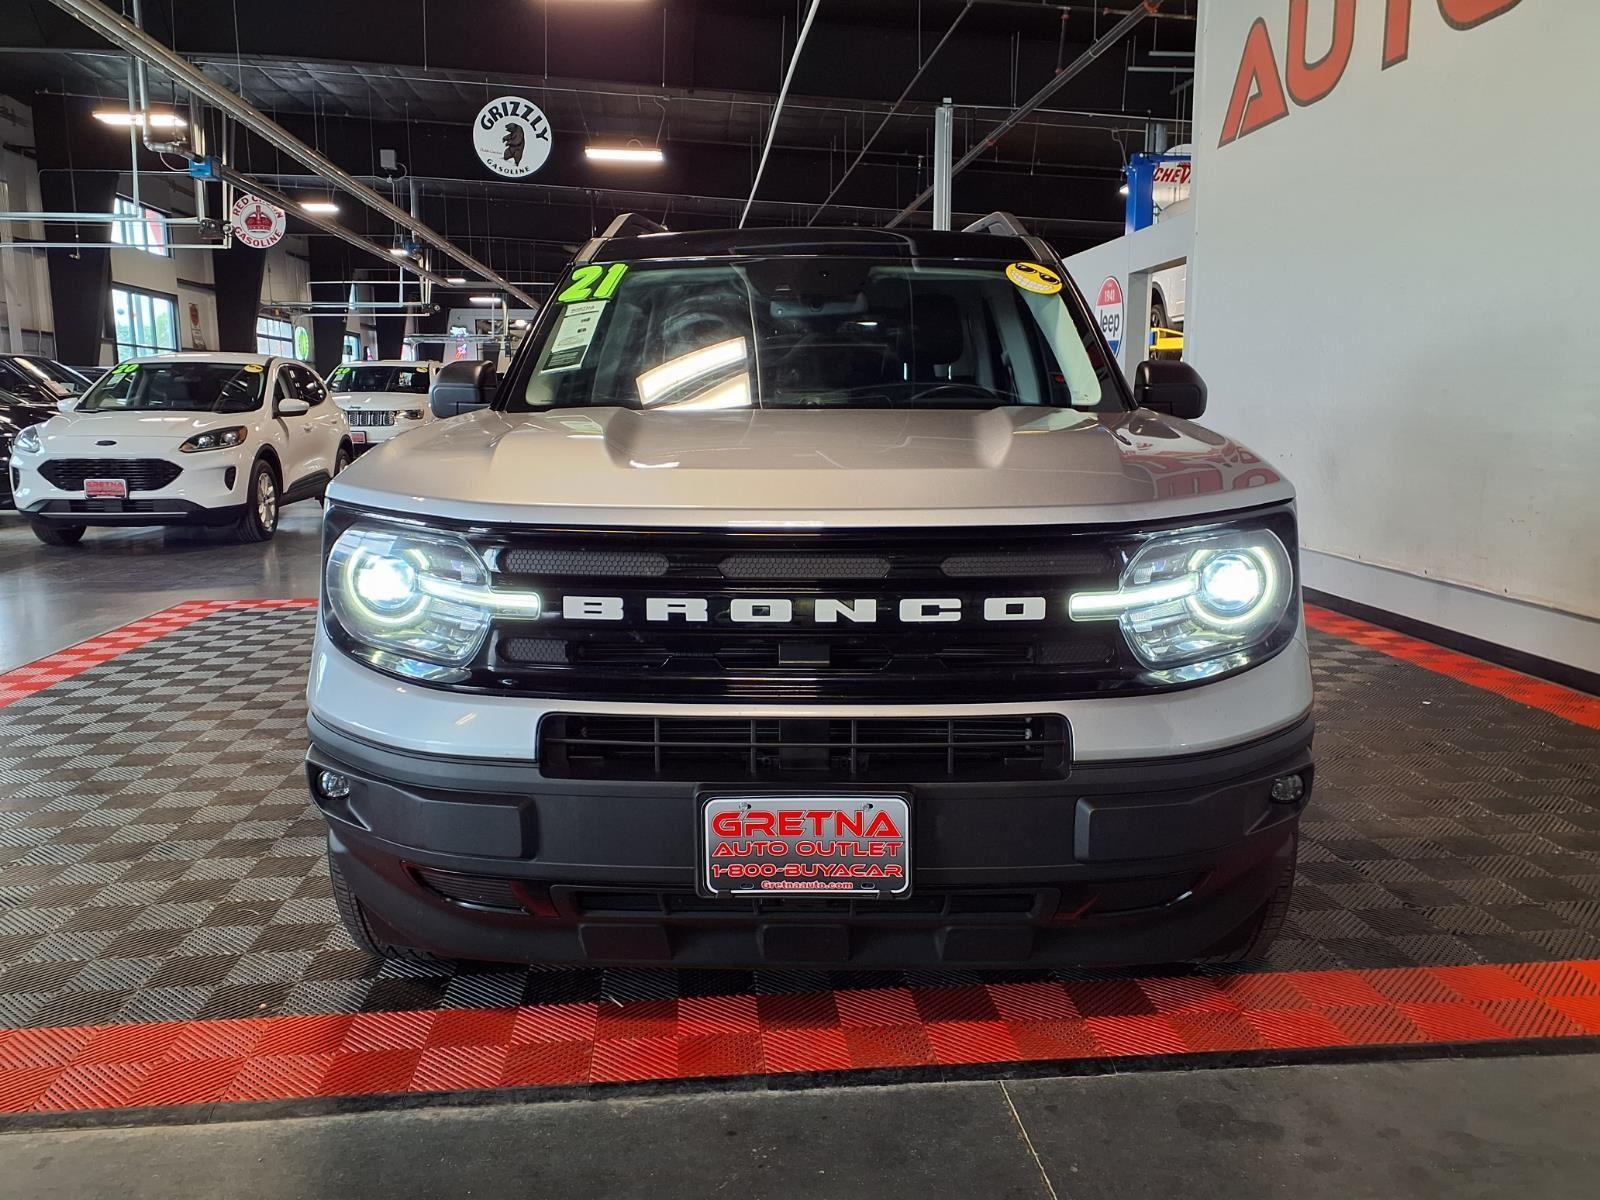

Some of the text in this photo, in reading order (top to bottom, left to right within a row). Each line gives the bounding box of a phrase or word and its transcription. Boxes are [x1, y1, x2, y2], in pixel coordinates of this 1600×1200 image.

[480, 101, 549, 142] GRIZZLY
[486, 158, 530, 175] GASOLINE
[232, 197, 250, 217] RED
[234, 226, 282, 247] GASOLINE
[557, 263, 629, 303] 21
[1103, 288, 1116, 303] 1941
[1100, 308, 1120, 338] Jeep
[110, 363, 140, 375] 20
[562, 595, 1047, 623] BRONCO
[711, 810, 903, 838] GRETNA
[711, 841, 904, 858] AUTO OUTLET
[711, 863, 904, 879] 1-800-BUYACAR
[760, 880, 854, 891] Gretnaauto.com
